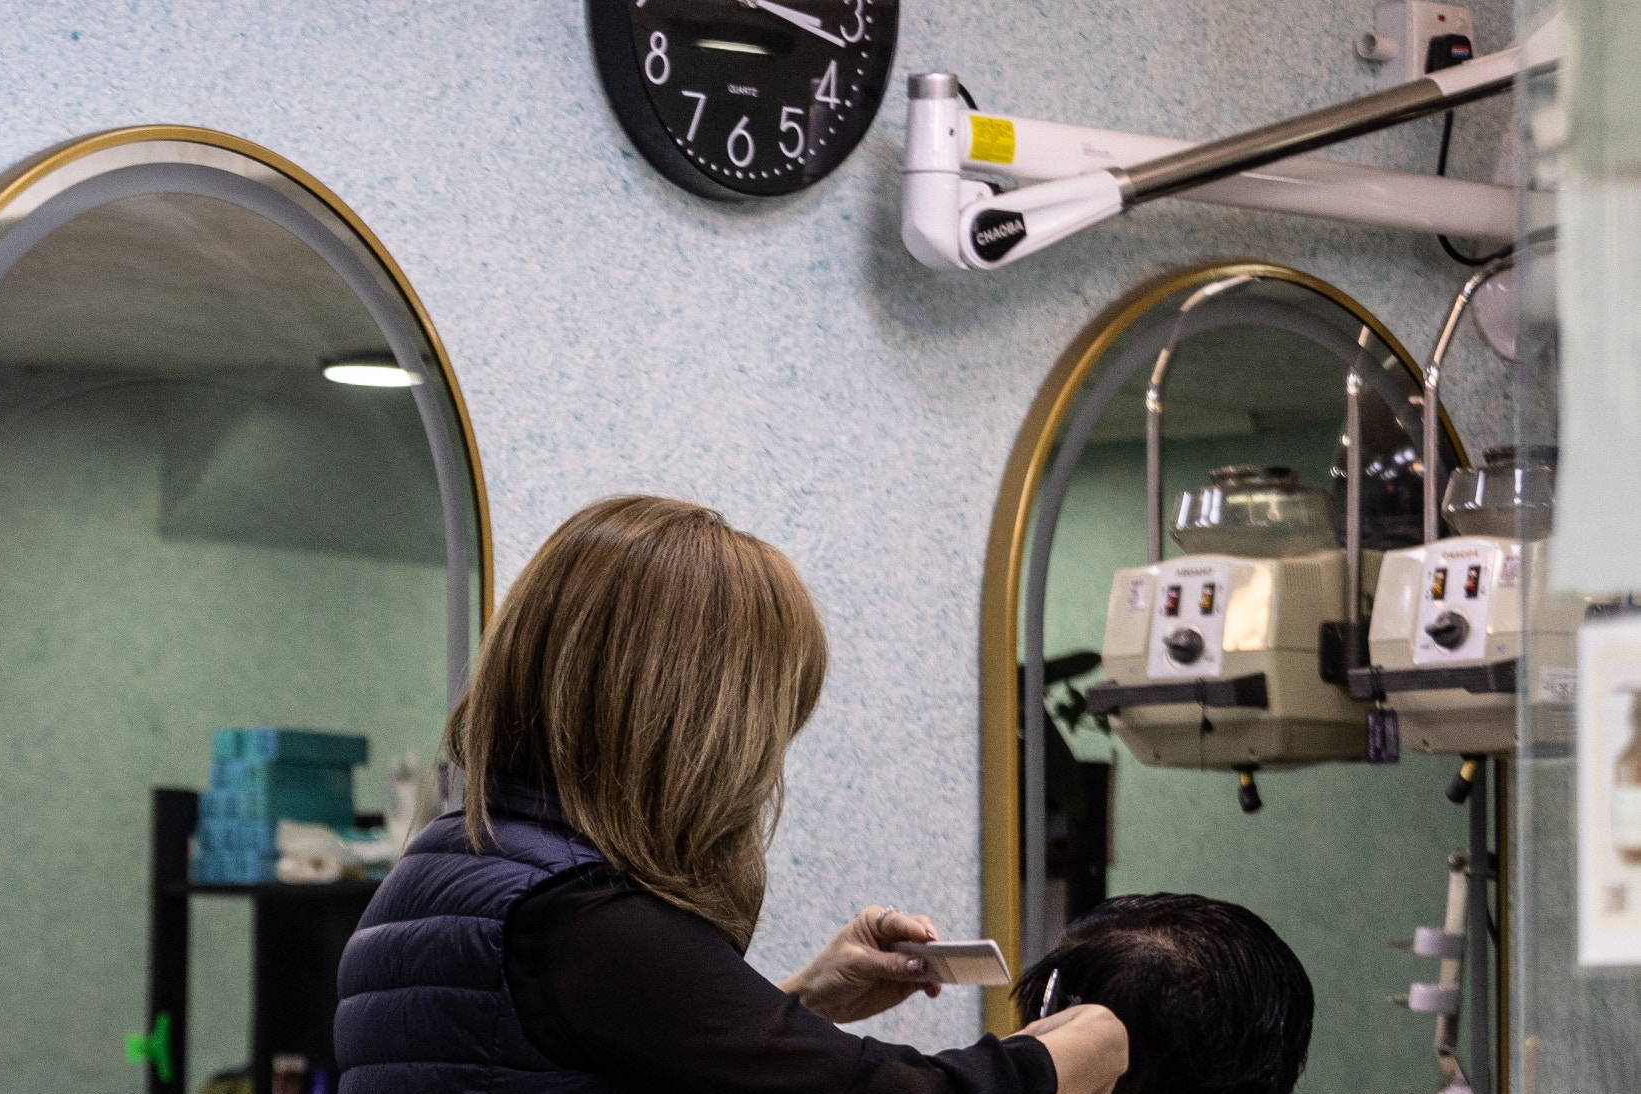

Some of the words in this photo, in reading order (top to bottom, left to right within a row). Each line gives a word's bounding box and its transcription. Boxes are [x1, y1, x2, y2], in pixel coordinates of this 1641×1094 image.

[644, 31, 670, 85] 8
[814, 60, 841, 109] 4
[681, 90, 706, 141] 7
[727, 115, 754, 167] 6
[779, 106, 805, 158] 5
